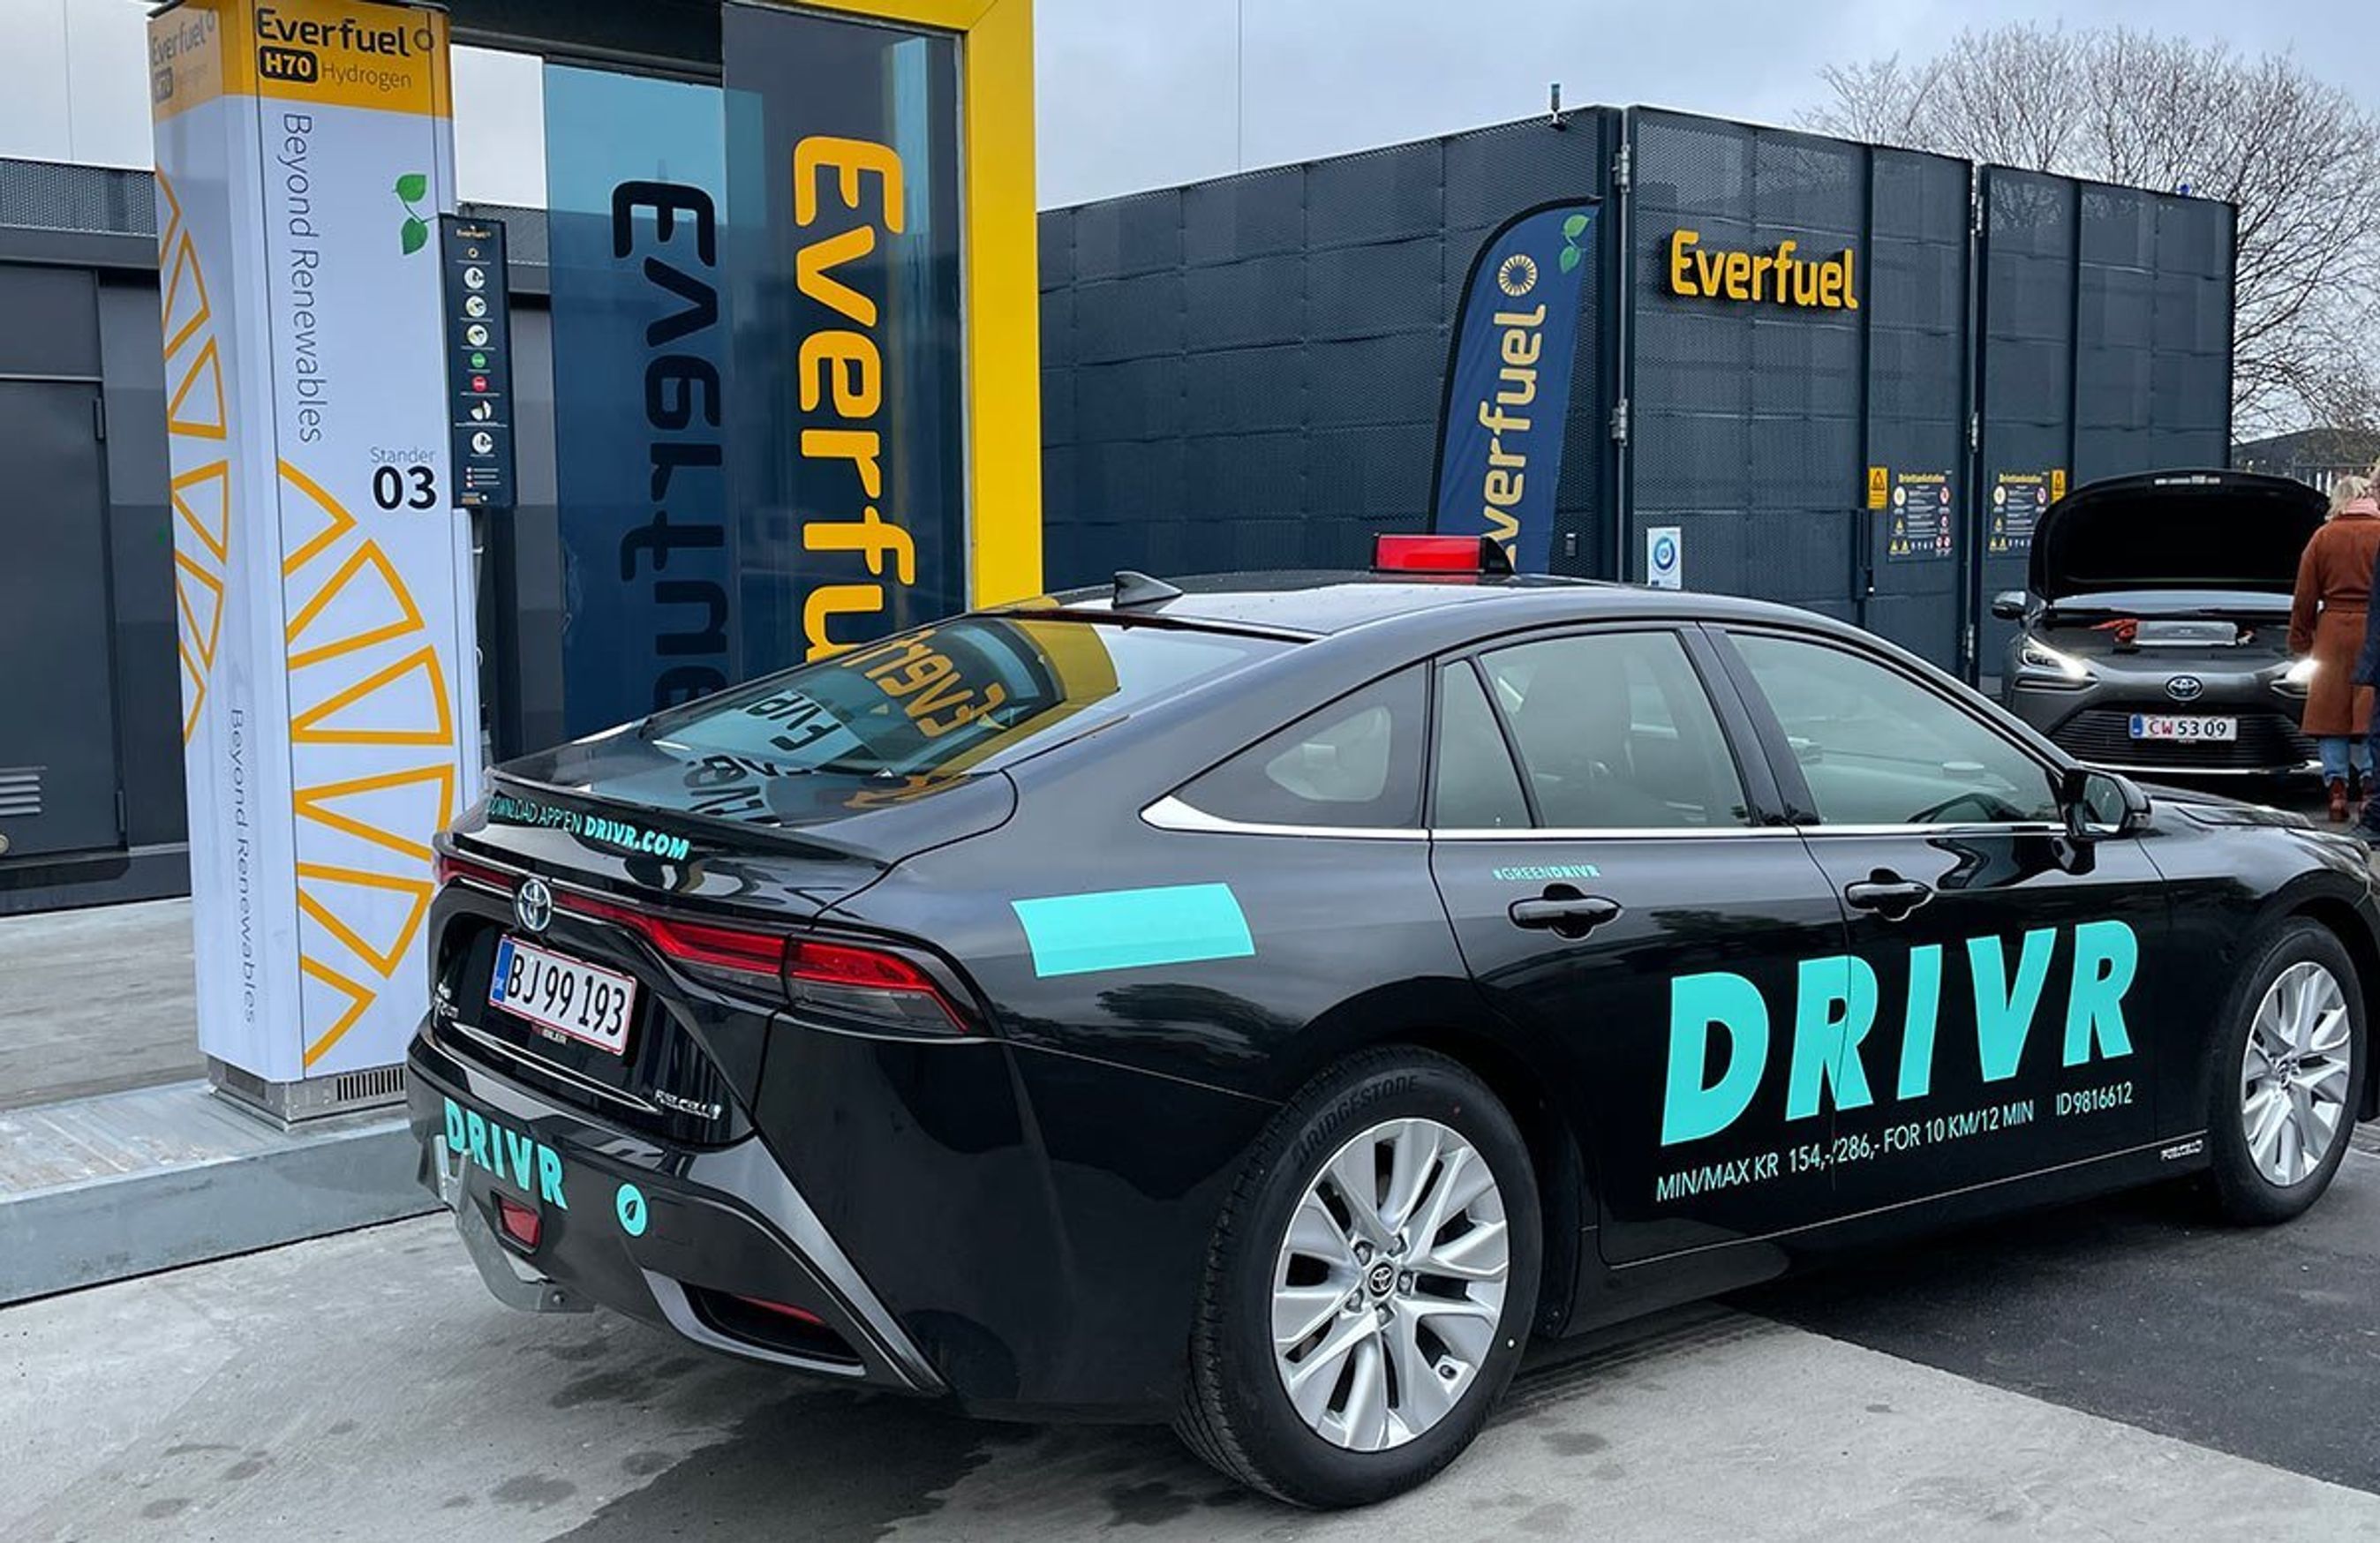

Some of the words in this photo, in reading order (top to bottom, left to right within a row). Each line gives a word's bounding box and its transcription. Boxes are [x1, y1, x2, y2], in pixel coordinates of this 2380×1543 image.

[257, 8, 410, 56] Everfuel
[265, 53, 311, 77] H70
[321, 62, 410, 92] Hydrogen
[277, 113, 320, 237] Beyond
[1670, 229, 1858, 310] Everfuel
[291, 249, 328, 442] Renewables
[795, 135, 915, 662] Everfu
[1479, 304, 1547, 569] verfuel
[371, 446, 436, 463] Stander
[373, 465, 437, 510] 03
[230, 709, 249, 826] Beyond
[2149, 719, 2173, 735] CW
[2178, 719, 2199, 736] 53
[2204, 720, 2226, 737] 09
[584, 815, 689, 861] DRIVR.COM
[237, 839, 256, 1024] Renewables
[508, 953, 540, 1005] BJ
[544, 966, 574, 1019] 99
[577, 975, 625, 1036] 193
[1661, 920, 2138, 1147] DRIVR
[444, 1095, 569, 1210] DRIVR
[1656, 1157, 1751, 1202] MIN/MAX
[1754, 1152, 1779, 1181] KR
[1884, 1123, 1921, 1153] FOR
[1925, 1118, 1945, 1143] 10
[1948, 1106, 1999, 1140] KM/12
[2003, 1100, 2034, 1127] MIN
